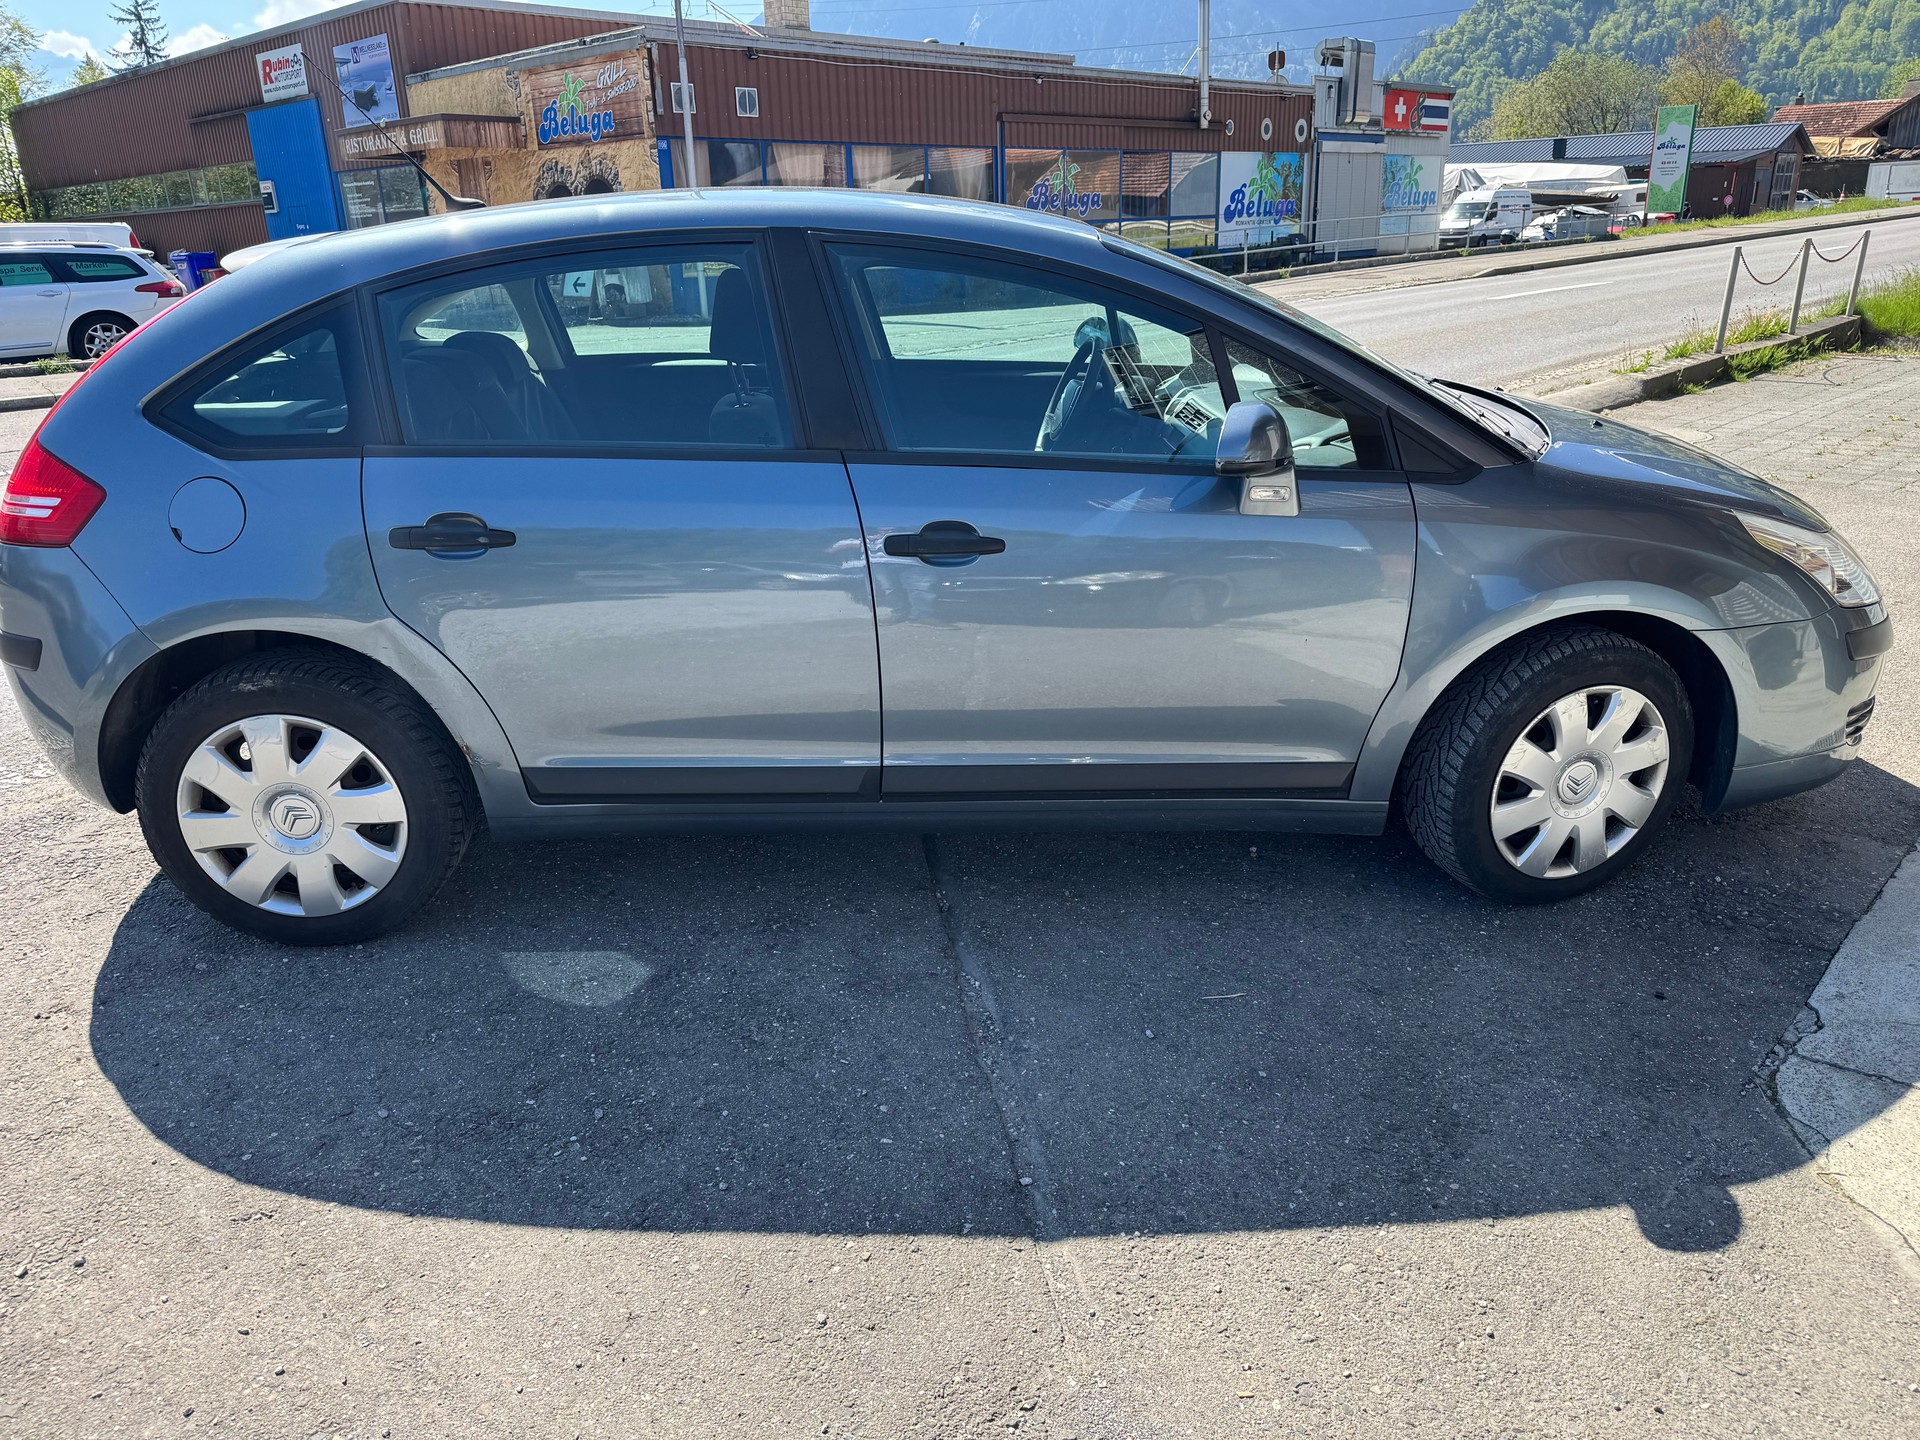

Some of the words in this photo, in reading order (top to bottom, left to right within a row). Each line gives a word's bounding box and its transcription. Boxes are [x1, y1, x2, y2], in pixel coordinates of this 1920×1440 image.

[262, 56, 290, 85] Rubin
[274, 68, 302, 83] MOTORSPORT
[596, 58, 627, 90] GRILL
[601, 92, 607, 103] &
[539, 99, 616, 144] Beluga
[345, 131, 398, 155] RISTORANTE
[400, 128, 408, 146] &
[409, 126, 439, 145] GRILL
[1656, 140, 1686, 151] Beluga
[1026, 176, 1102, 218] Beluga
[1223, 182, 1296, 225] Beluga
[1384, 177, 1437, 213] Beluga
